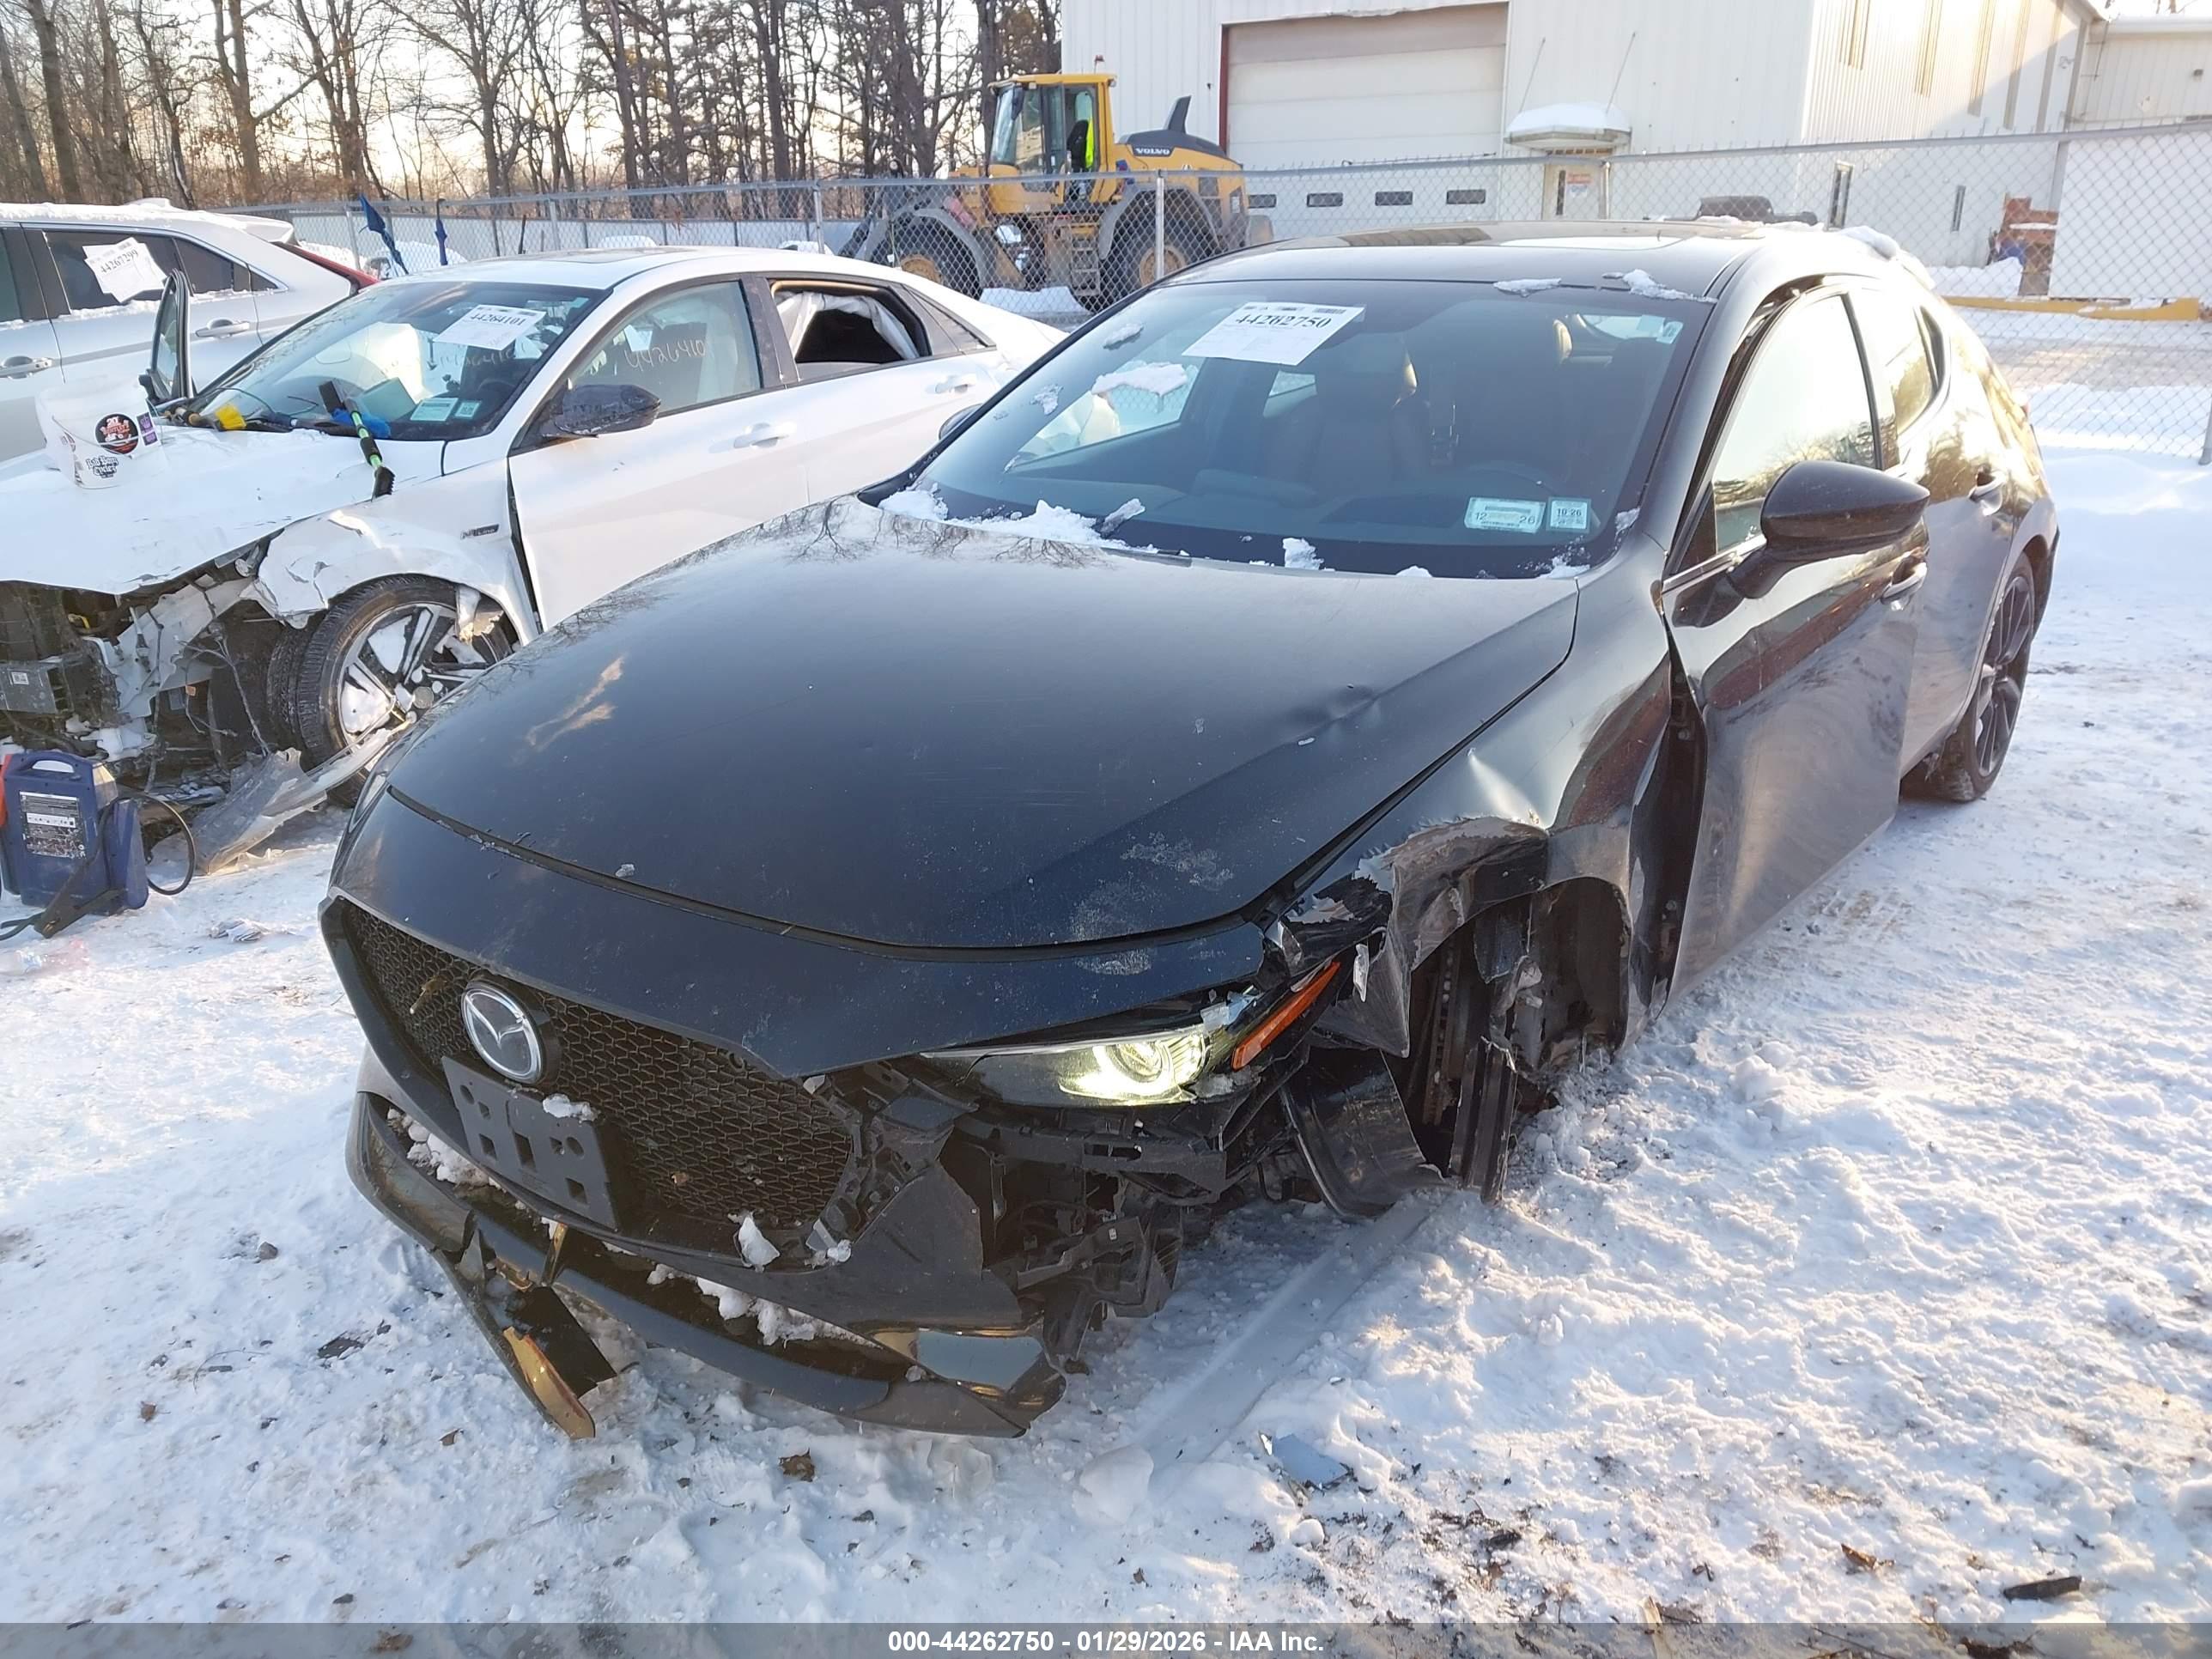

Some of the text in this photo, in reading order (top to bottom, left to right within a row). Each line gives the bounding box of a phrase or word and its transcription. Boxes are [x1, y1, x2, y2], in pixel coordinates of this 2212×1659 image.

[1237, 314, 1332, 327] 44262750
[1476, 512, 1535, 525] 12 26
